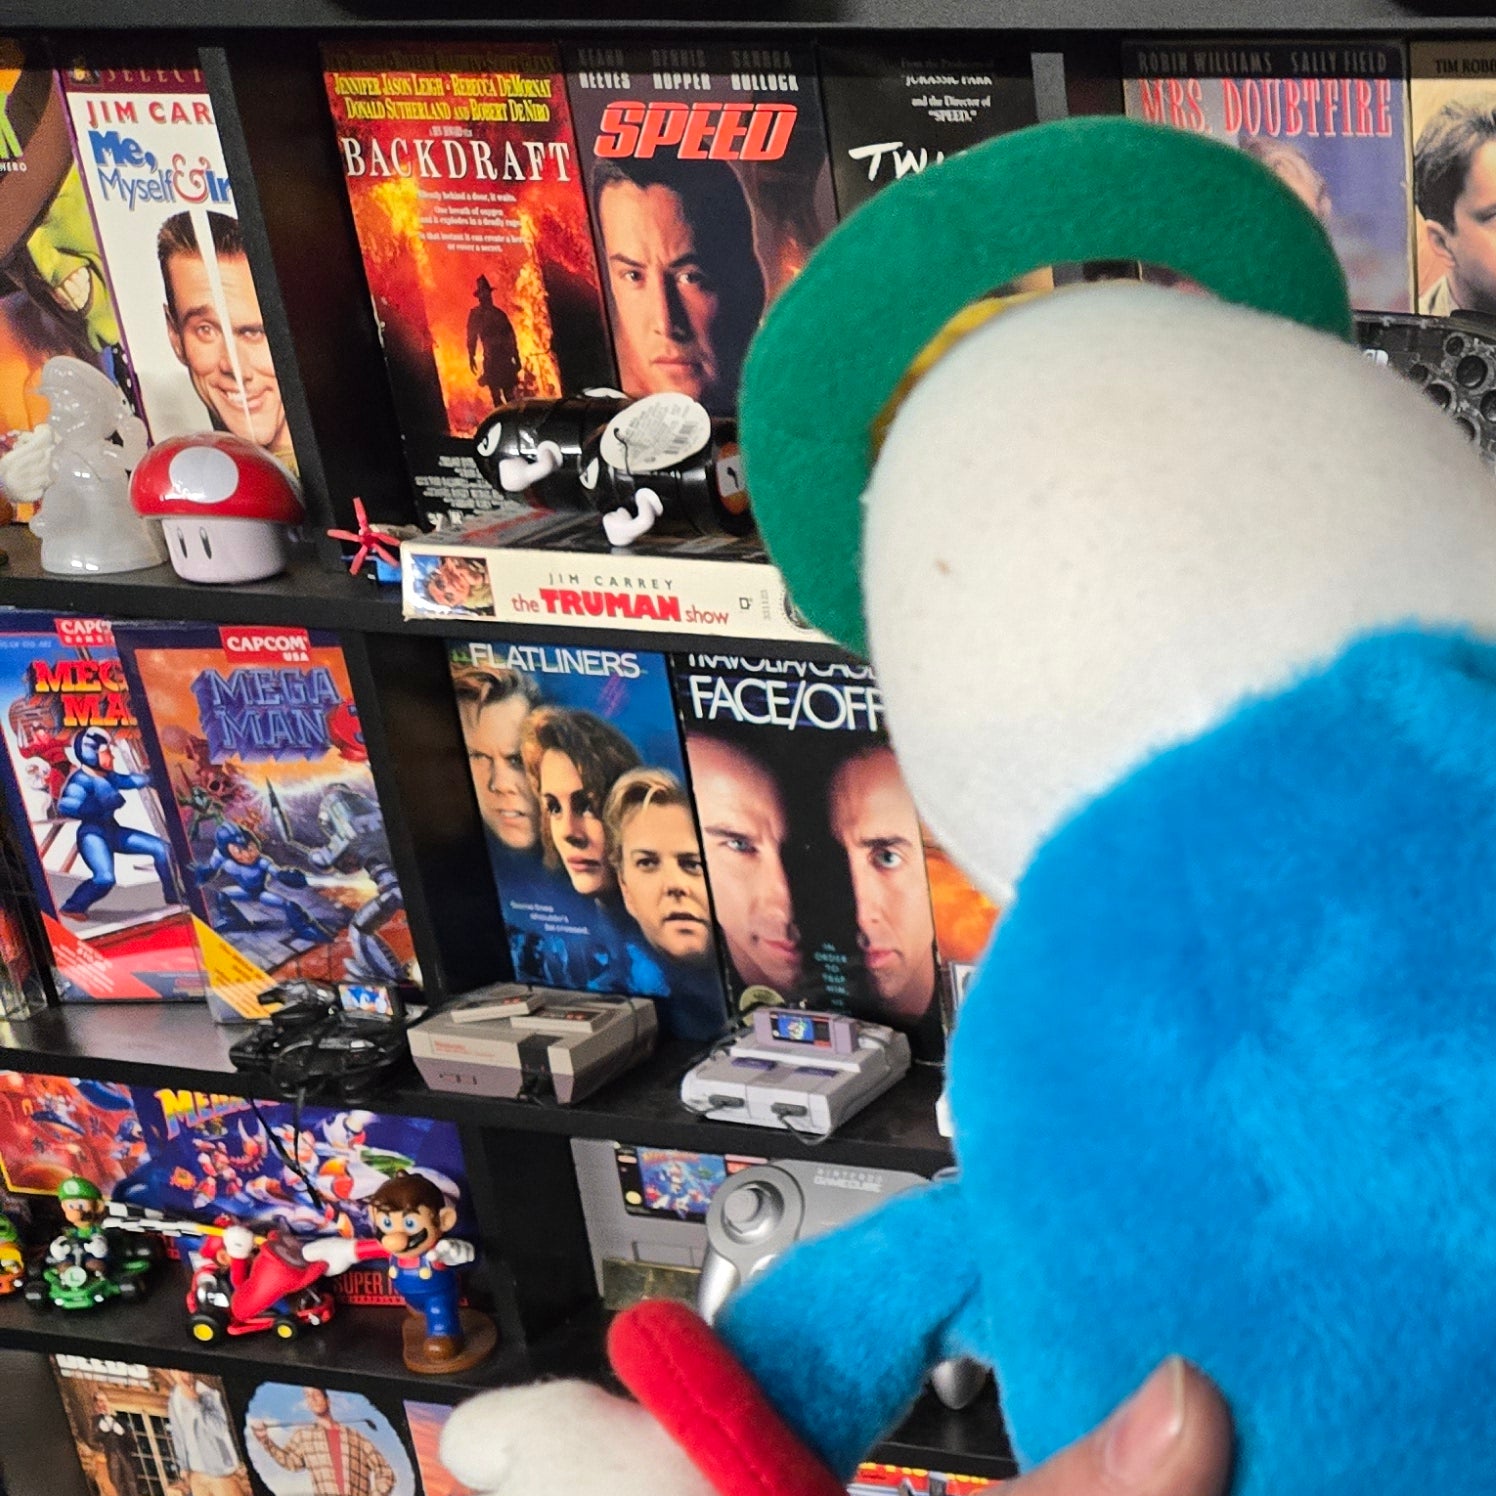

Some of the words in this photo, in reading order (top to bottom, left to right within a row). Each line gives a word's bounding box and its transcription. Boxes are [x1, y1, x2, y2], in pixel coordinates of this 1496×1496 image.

[579, 72, 631, 90] REEVES
[652, 73, 711, 91] HOPPER
[731, 73, 799, 91] BULLOCK
[1193, 53, 1271, 73] WILLIAMS
[1290, 54, 1336, 73] SALLY
[1343, 54, 1388, 73] FIELD
[1434, 59, 1458, 75] TIM
[86, 100, 138, 128] JIM
[1223, 79, 1394, 138] DOUBTFIRE
[594, 101, 798, 161] SPEED
[88, 130, 157, 173] Me,
[341, 136, 571, 182] BACKDRAFT
[549, 573, 581, 586] JIM
[595, 575, 673, 590] CARREY
[512, 594, 540, 613] the
[539, 588, 681, 622] TRUMAN
[686, 608, 729, 626] show
[227, 636, 306, 652] CAPCOM
[282, 652, 309, 662] USA
[468, 642, 642, 680] FLATLINERS
[191, 668, 343, 705] MEGA
[689, 675, 885, 732] FACE/OFF
[212, 708, 330, 750] MAN
